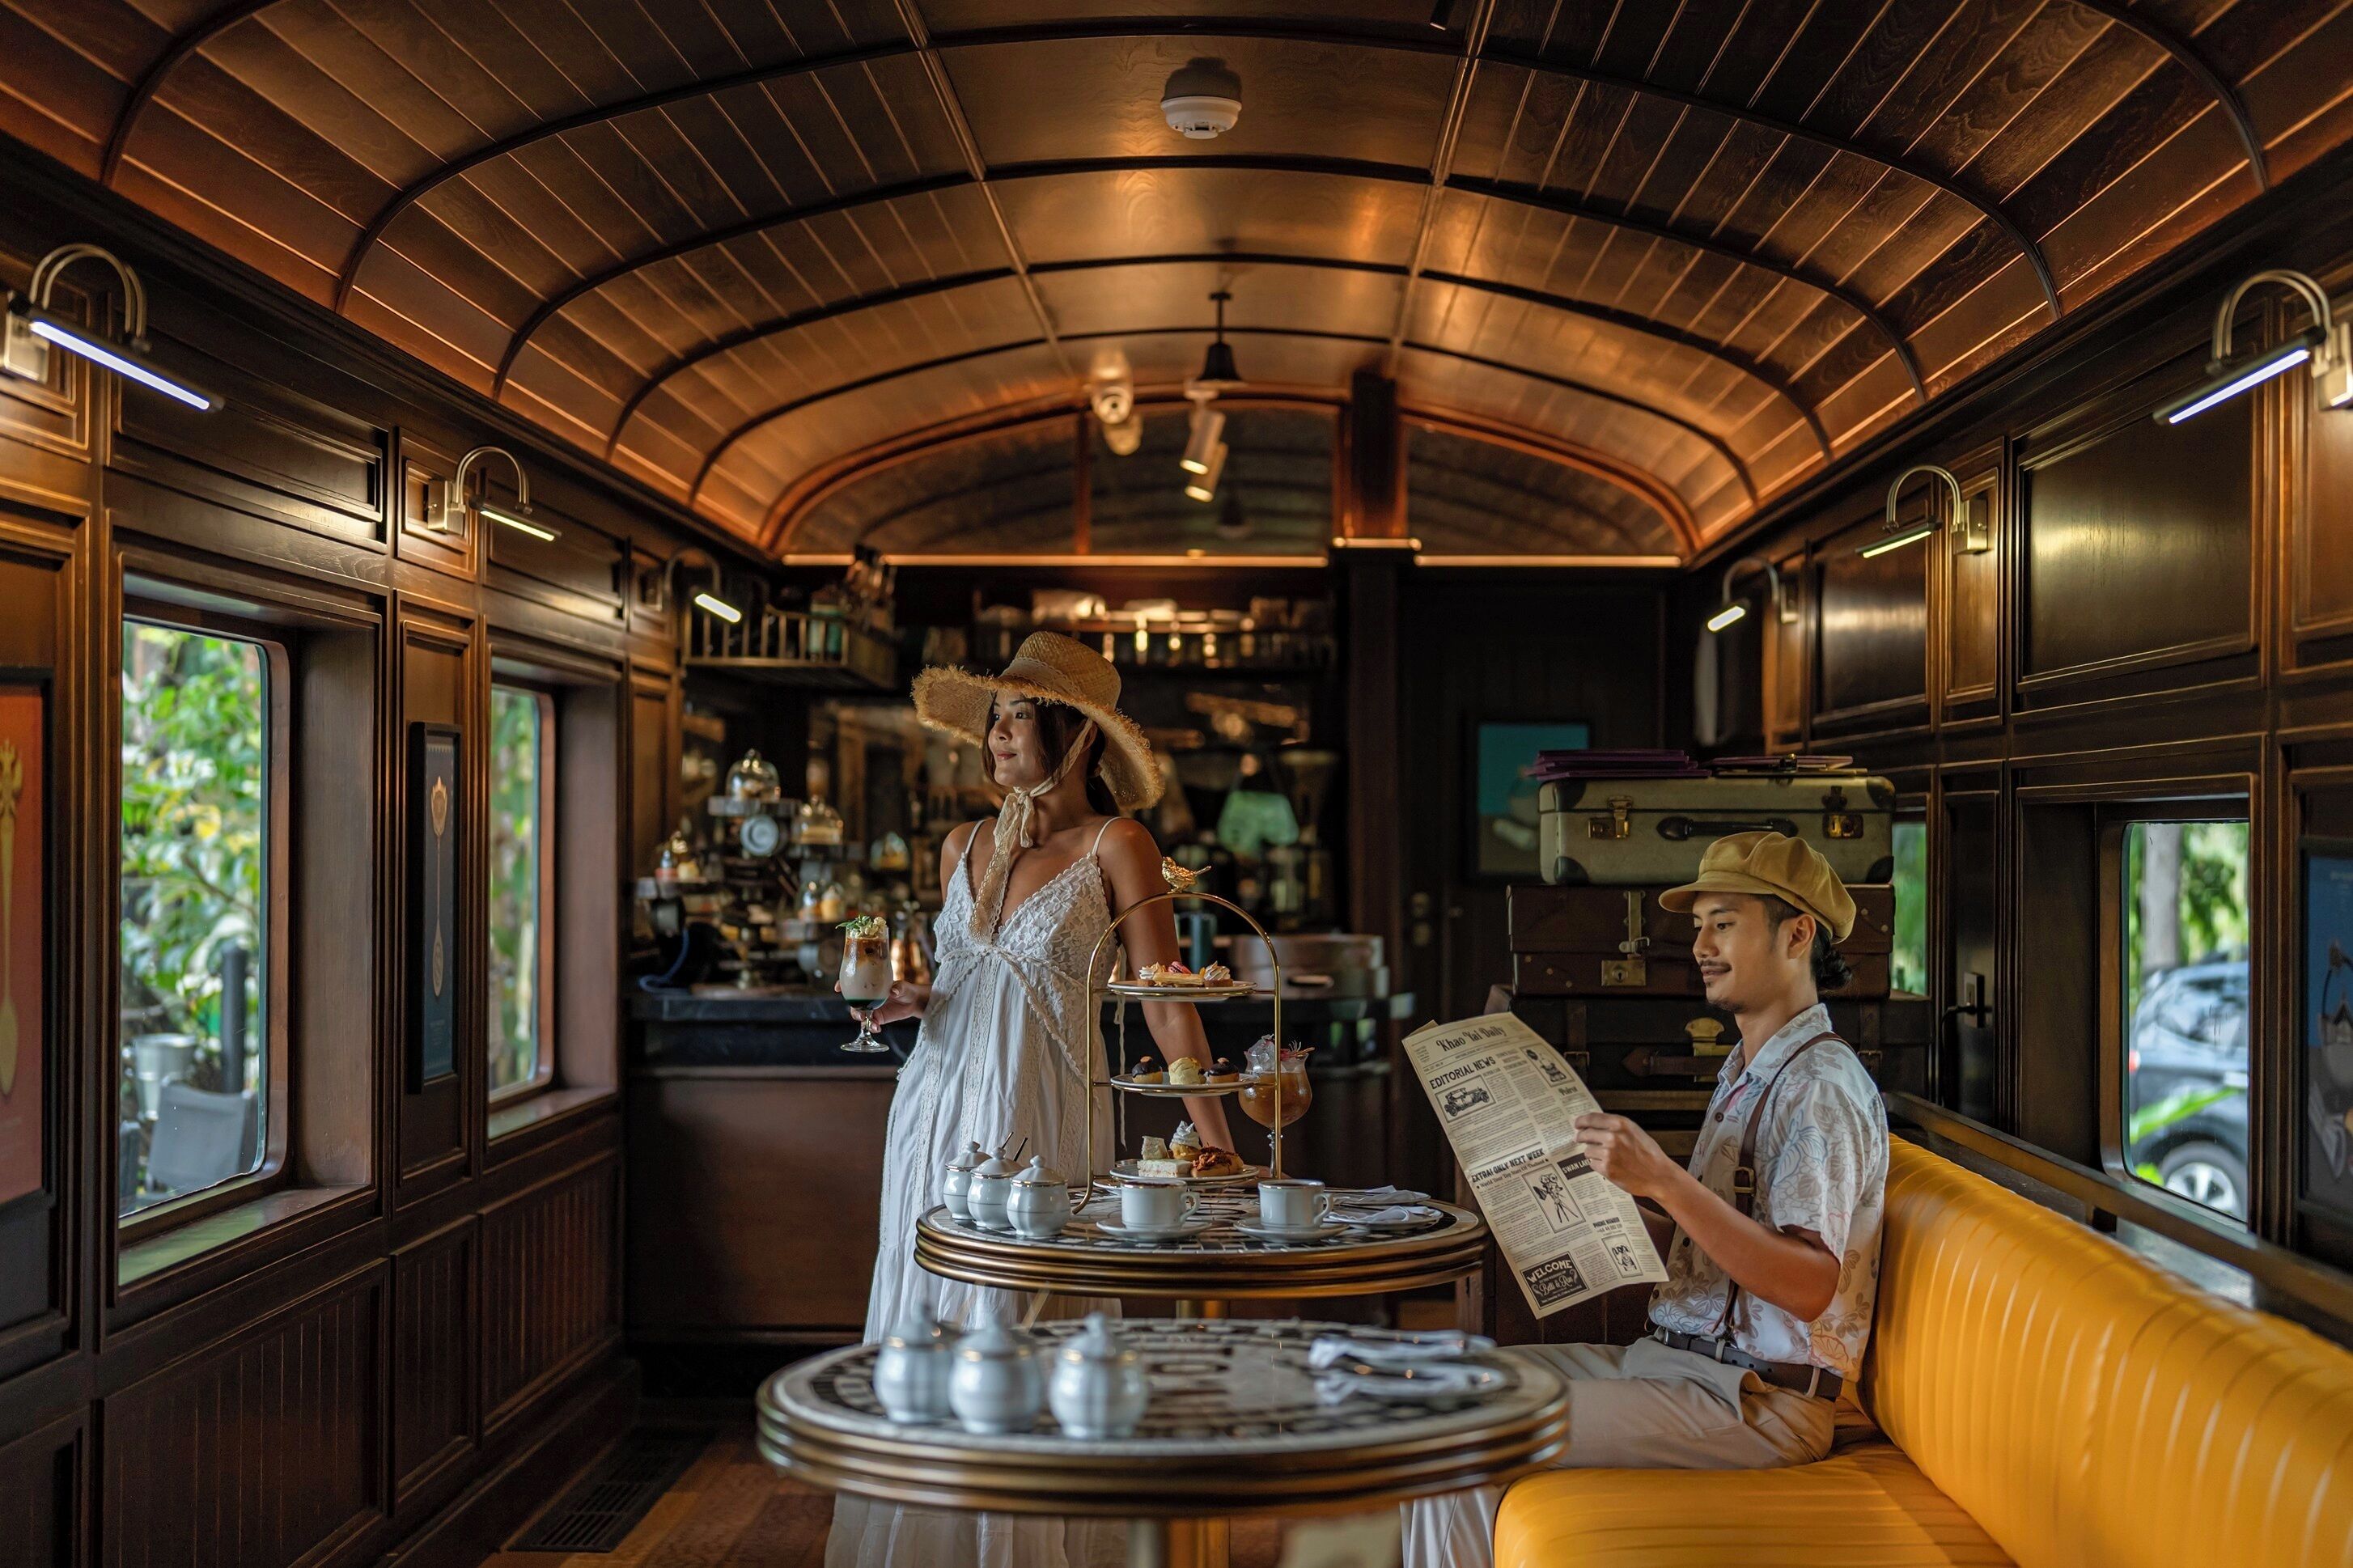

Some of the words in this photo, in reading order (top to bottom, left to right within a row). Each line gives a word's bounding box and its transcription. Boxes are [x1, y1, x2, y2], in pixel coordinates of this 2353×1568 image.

[1436, 1036, 1466, 1052] Khao
[1462, 1030, 1483, 1042] Yai
[1479, 1026, 1507, 1038] Daily
[1429, 1064, 1474, 1090] EDITORIAL
[1473, 1056, 1496, 1071] NEWS
[1493, 1162, 1510, 1174] ONLY
[1509, 1155, 1527, 1168] NEXT
[1526, 1148, 1545, 1161] WEEK
[1562, 1162, 1579, 1174] SWAN
[1527, 1260, 1573, 1283] WELCOME
